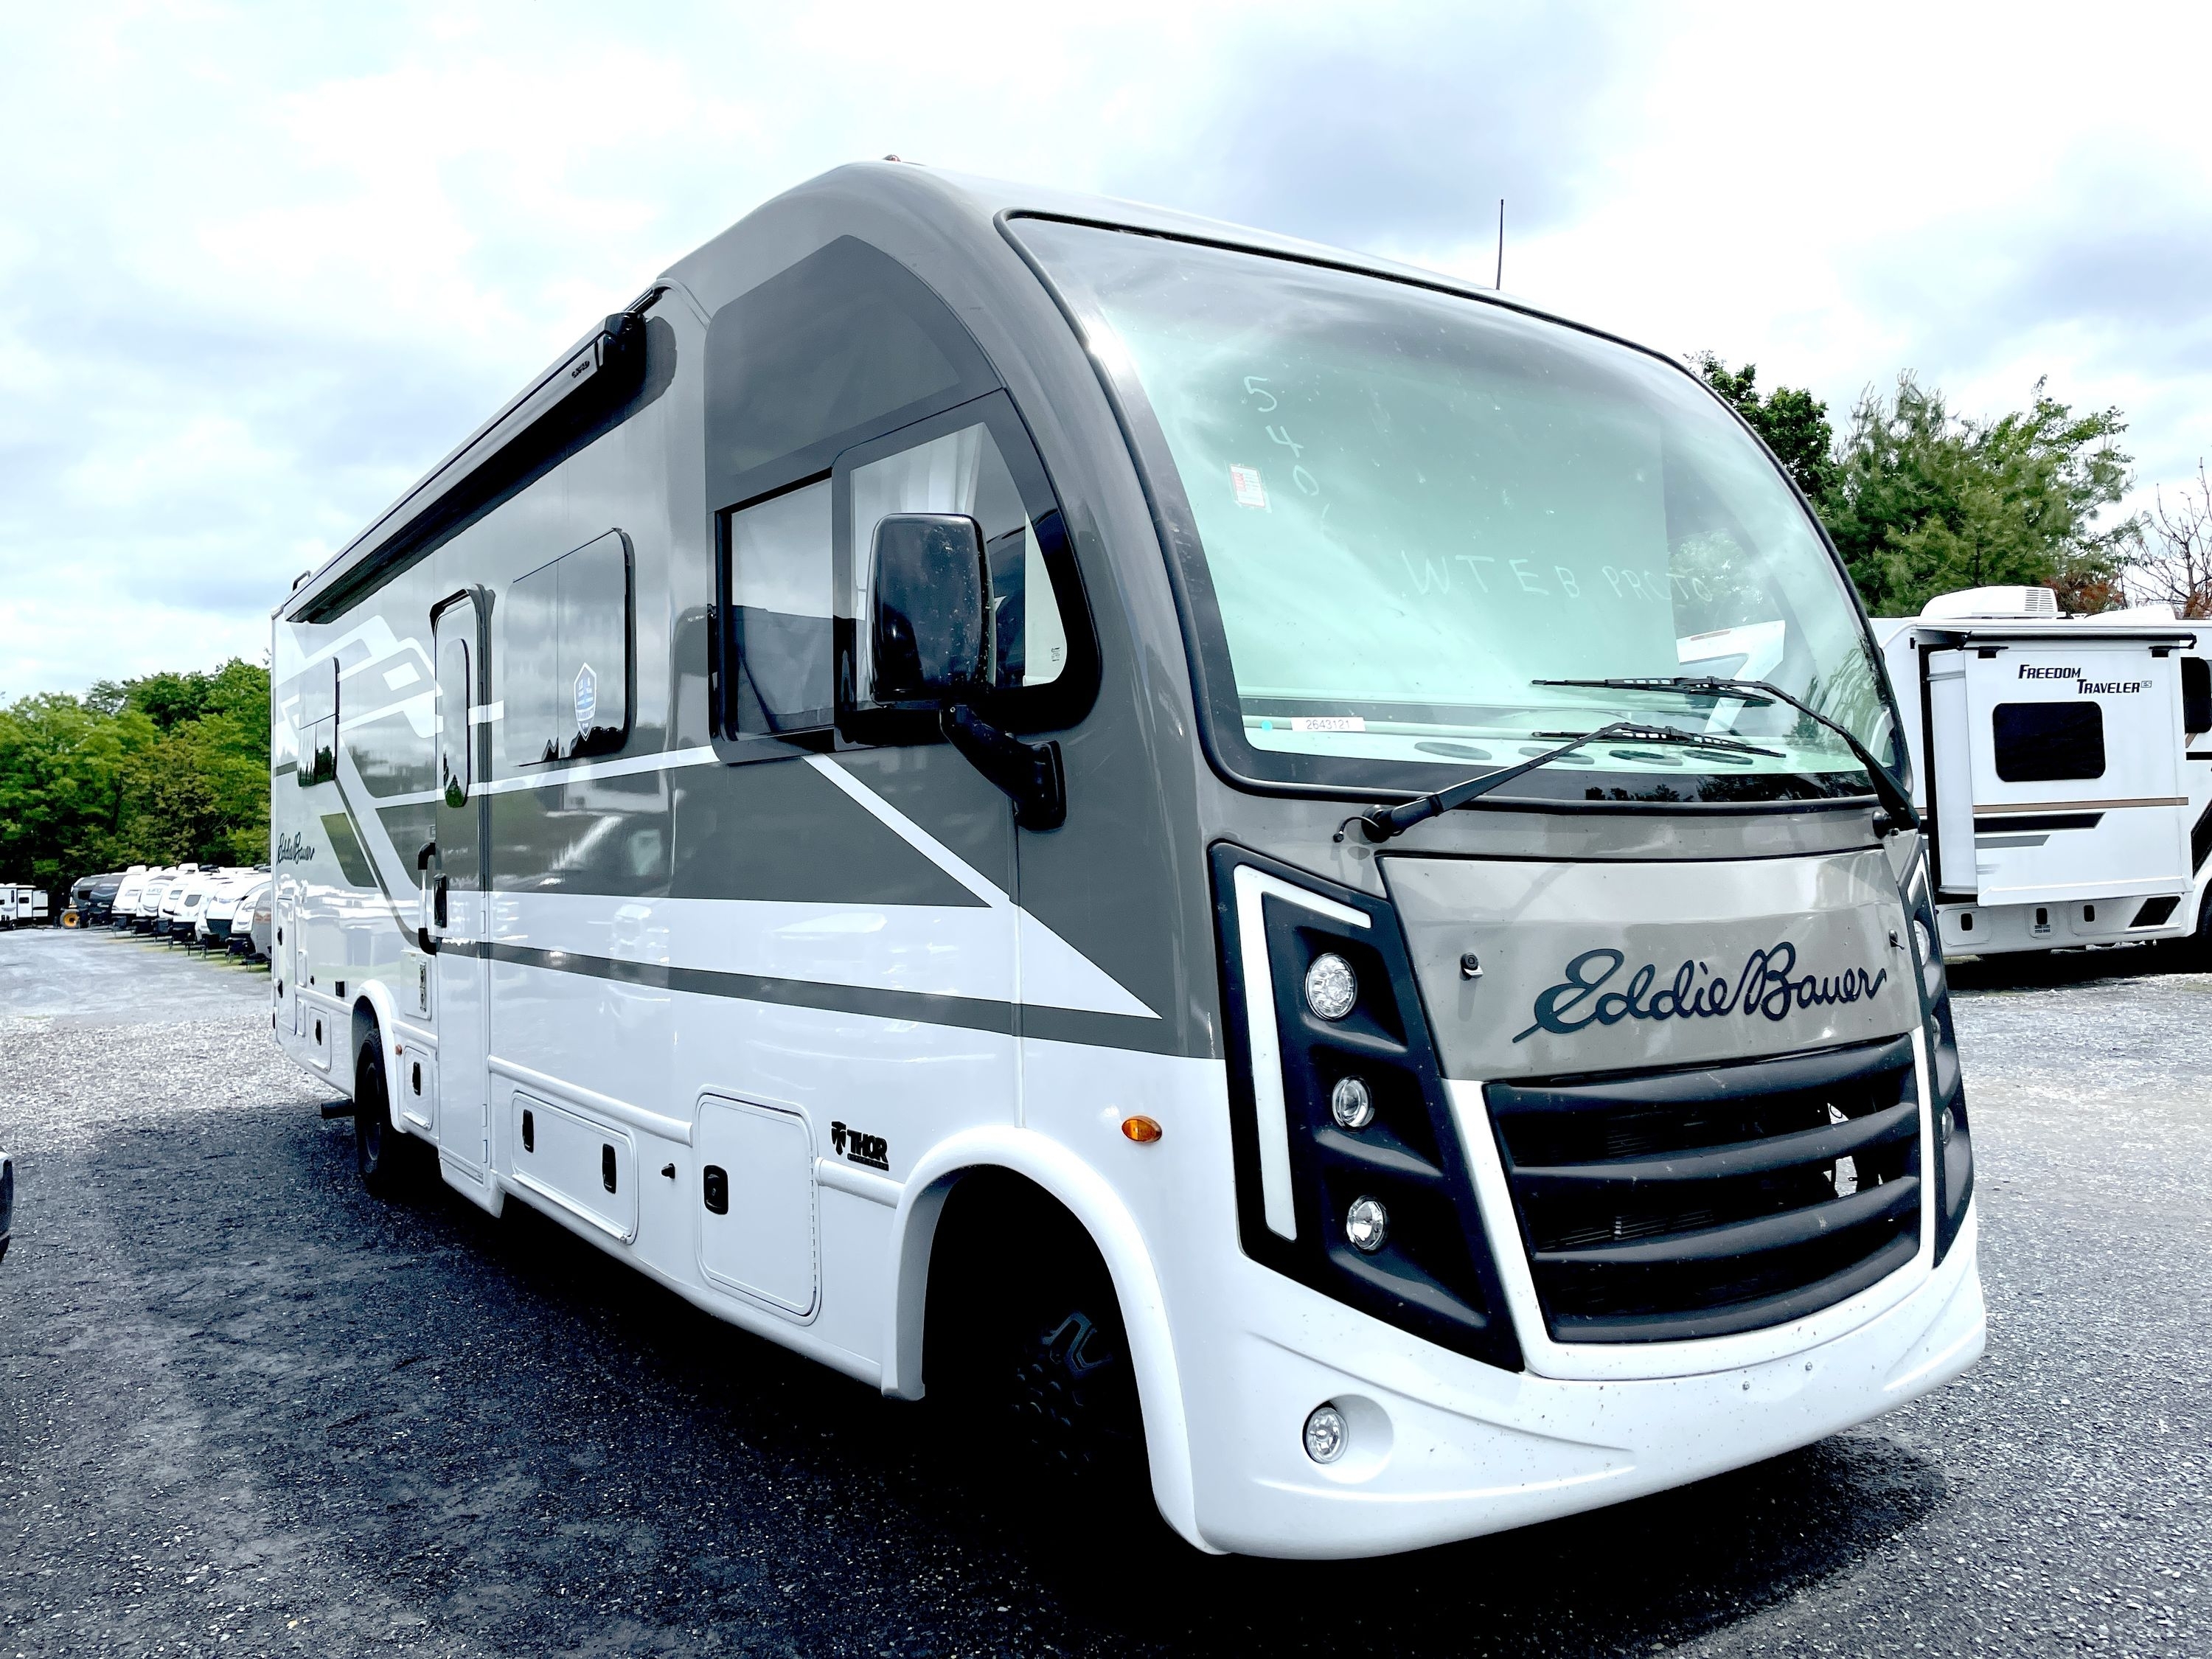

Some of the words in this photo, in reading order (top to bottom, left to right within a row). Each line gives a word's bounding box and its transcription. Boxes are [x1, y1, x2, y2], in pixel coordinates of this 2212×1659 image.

[2018, 664, 2081, 679] FREEDOM
[2076, 678, 2140, 694] TRAVELER
[1305, 719, 1350, 730] 2643121
[1512, 948, 1736, 1043] Eddie
[1743, 941, 1887, 1021] Bauer
[846, 1129, 888, 1164] THOR
